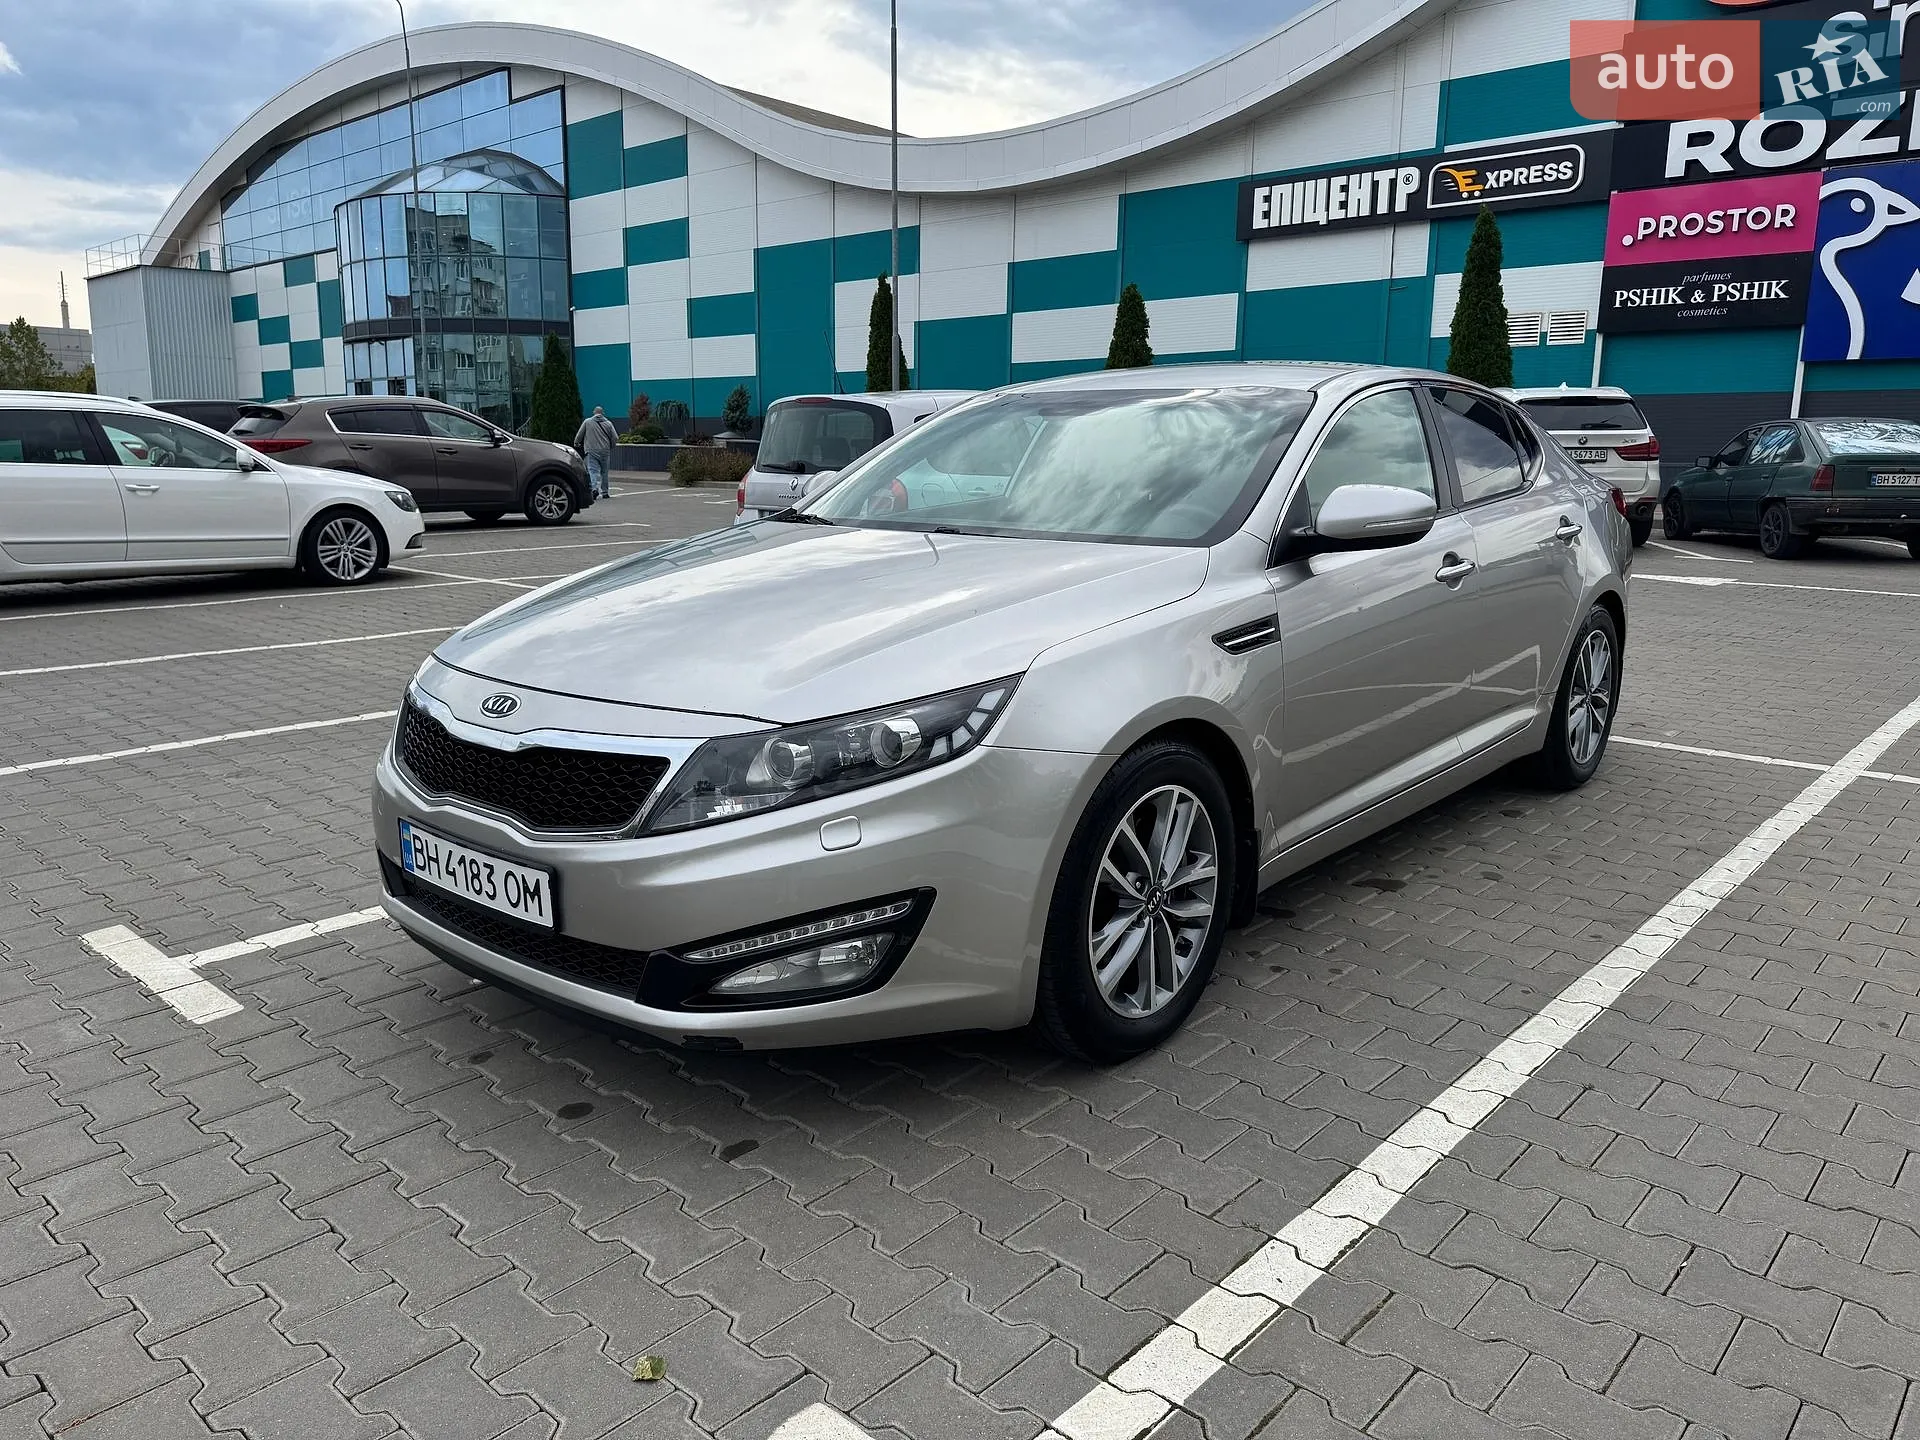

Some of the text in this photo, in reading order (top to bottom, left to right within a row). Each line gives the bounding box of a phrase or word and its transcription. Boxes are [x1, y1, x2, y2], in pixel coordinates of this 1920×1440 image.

[1664, 89, 1920, 179] ROZ
[1440, 160, 1575, 194] EXPRESS
[1252, 166, 1421, 230] ЕПІЦЕНТР
[1682, 271, 1732, 285] parfumes
[1613, 279, 1789, 308] PSHIK & PSHIK
[1677, 306, 1729, 318] cosmetics
[1573, 450, 1593, 458] 5673
[1594, 450, 1606, 458] AB
[1877, 475, 1890, 484] BH
[1891, 475, 1911, 484] 5127
[412, 834, 543, 917] BH 4183 OM
